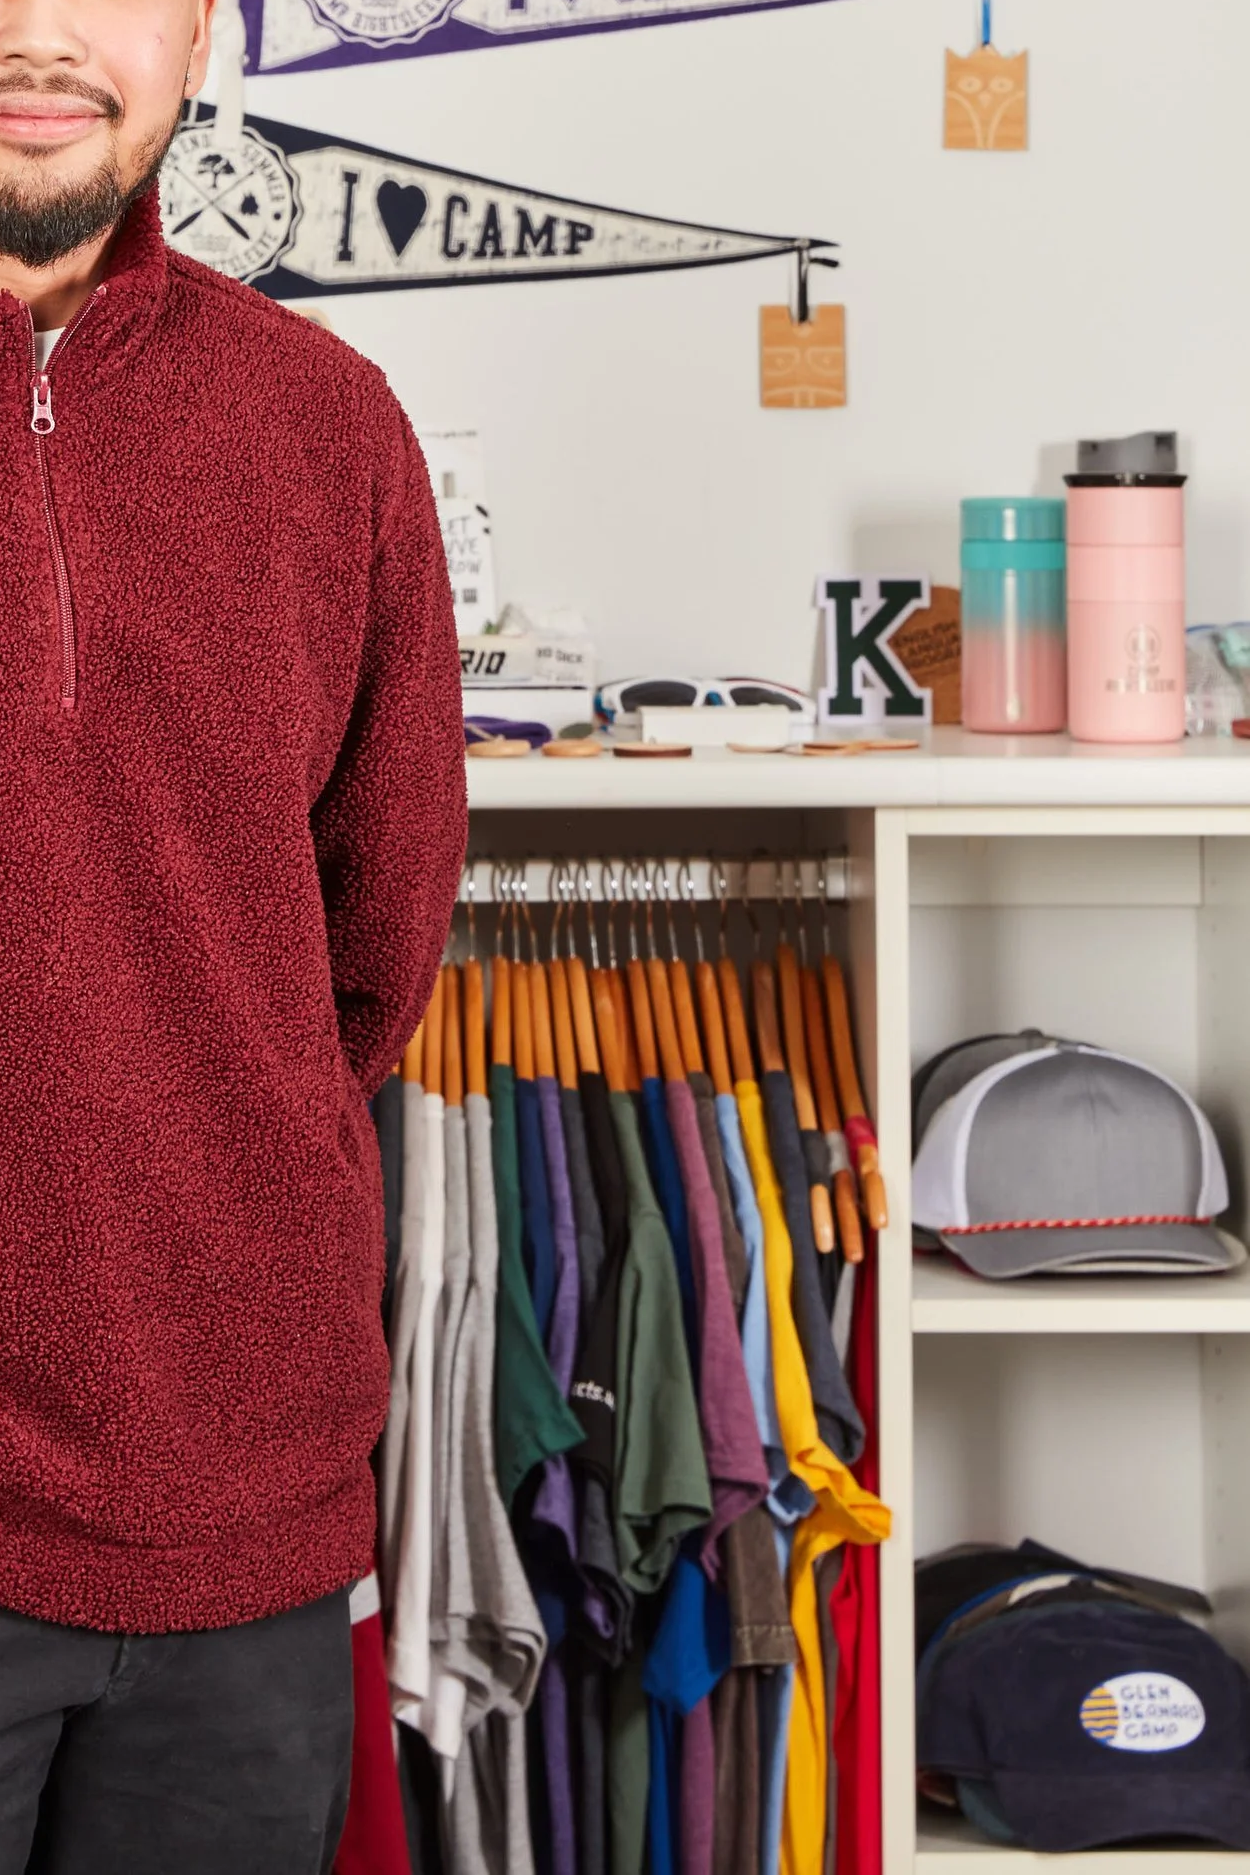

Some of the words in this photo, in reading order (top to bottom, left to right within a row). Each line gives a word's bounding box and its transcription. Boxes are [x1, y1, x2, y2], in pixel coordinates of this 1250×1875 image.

[336, 169, 359, 262] I
[441, 193, 595, 259] CAMP
[825, 580, 925, 715] K
[1120, 1683, 1171, 1701] GLEN
[1124, 1722, 1178, 1740] CAMP
